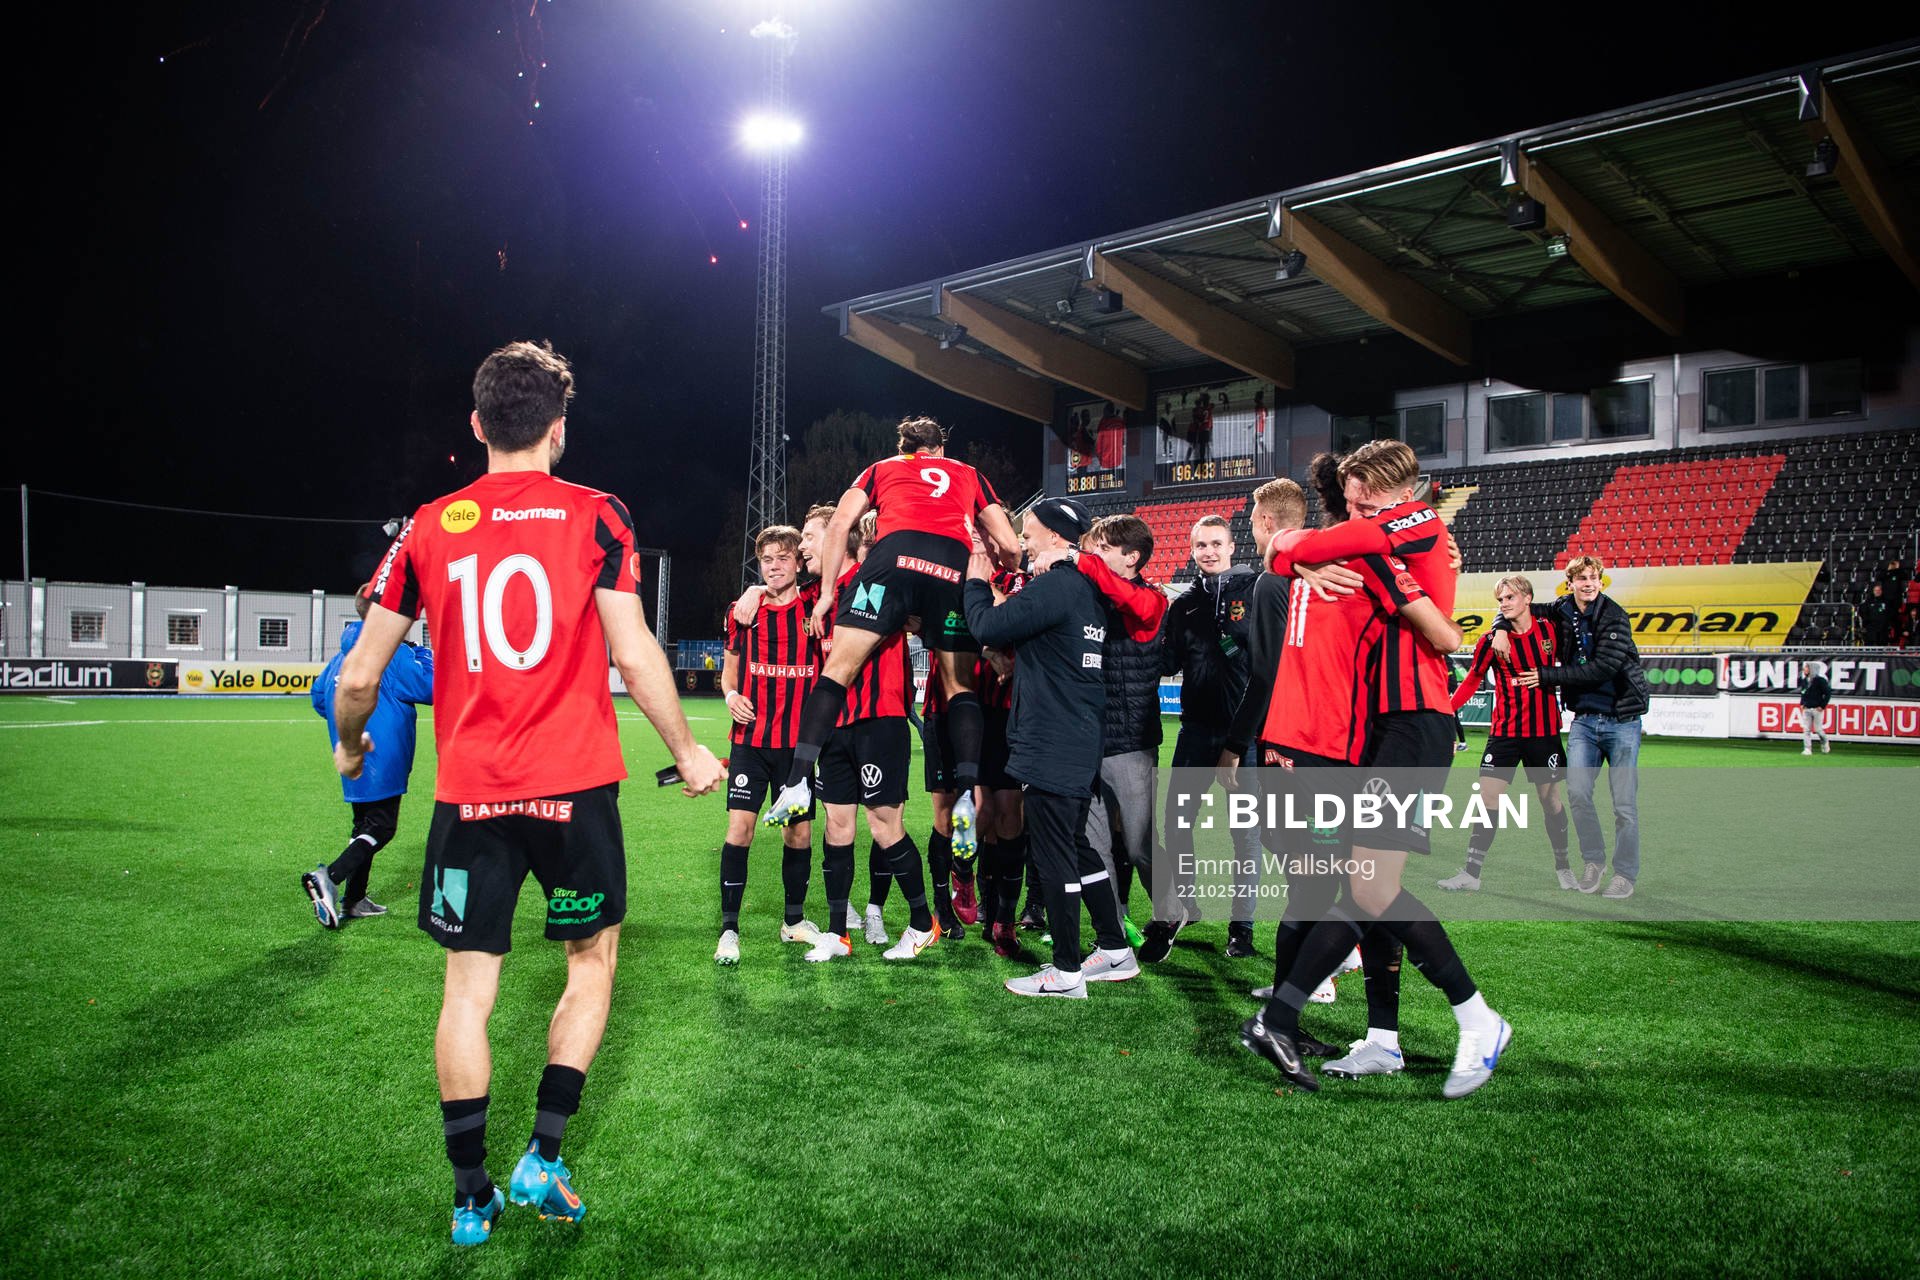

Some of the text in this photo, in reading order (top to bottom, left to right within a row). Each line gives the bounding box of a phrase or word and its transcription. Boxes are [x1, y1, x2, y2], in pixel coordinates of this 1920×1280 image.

[920, 467, 950, 498] 9
[446, 507, 567, 523] Yale Doorman
[898, 556, 961, 583] BAUHAUS
[447, 553, 553, 673] 10
[0, 661, 112, 687] tadium
[210, 669, 255, 688] Yale
[261, 669, 320, 688] Door
[749, 663, 815, 677] BAUHAUS
[1760, 705, 1918, 733] BAUHAU
[462, 800, 574, 820] BAUHAUS
